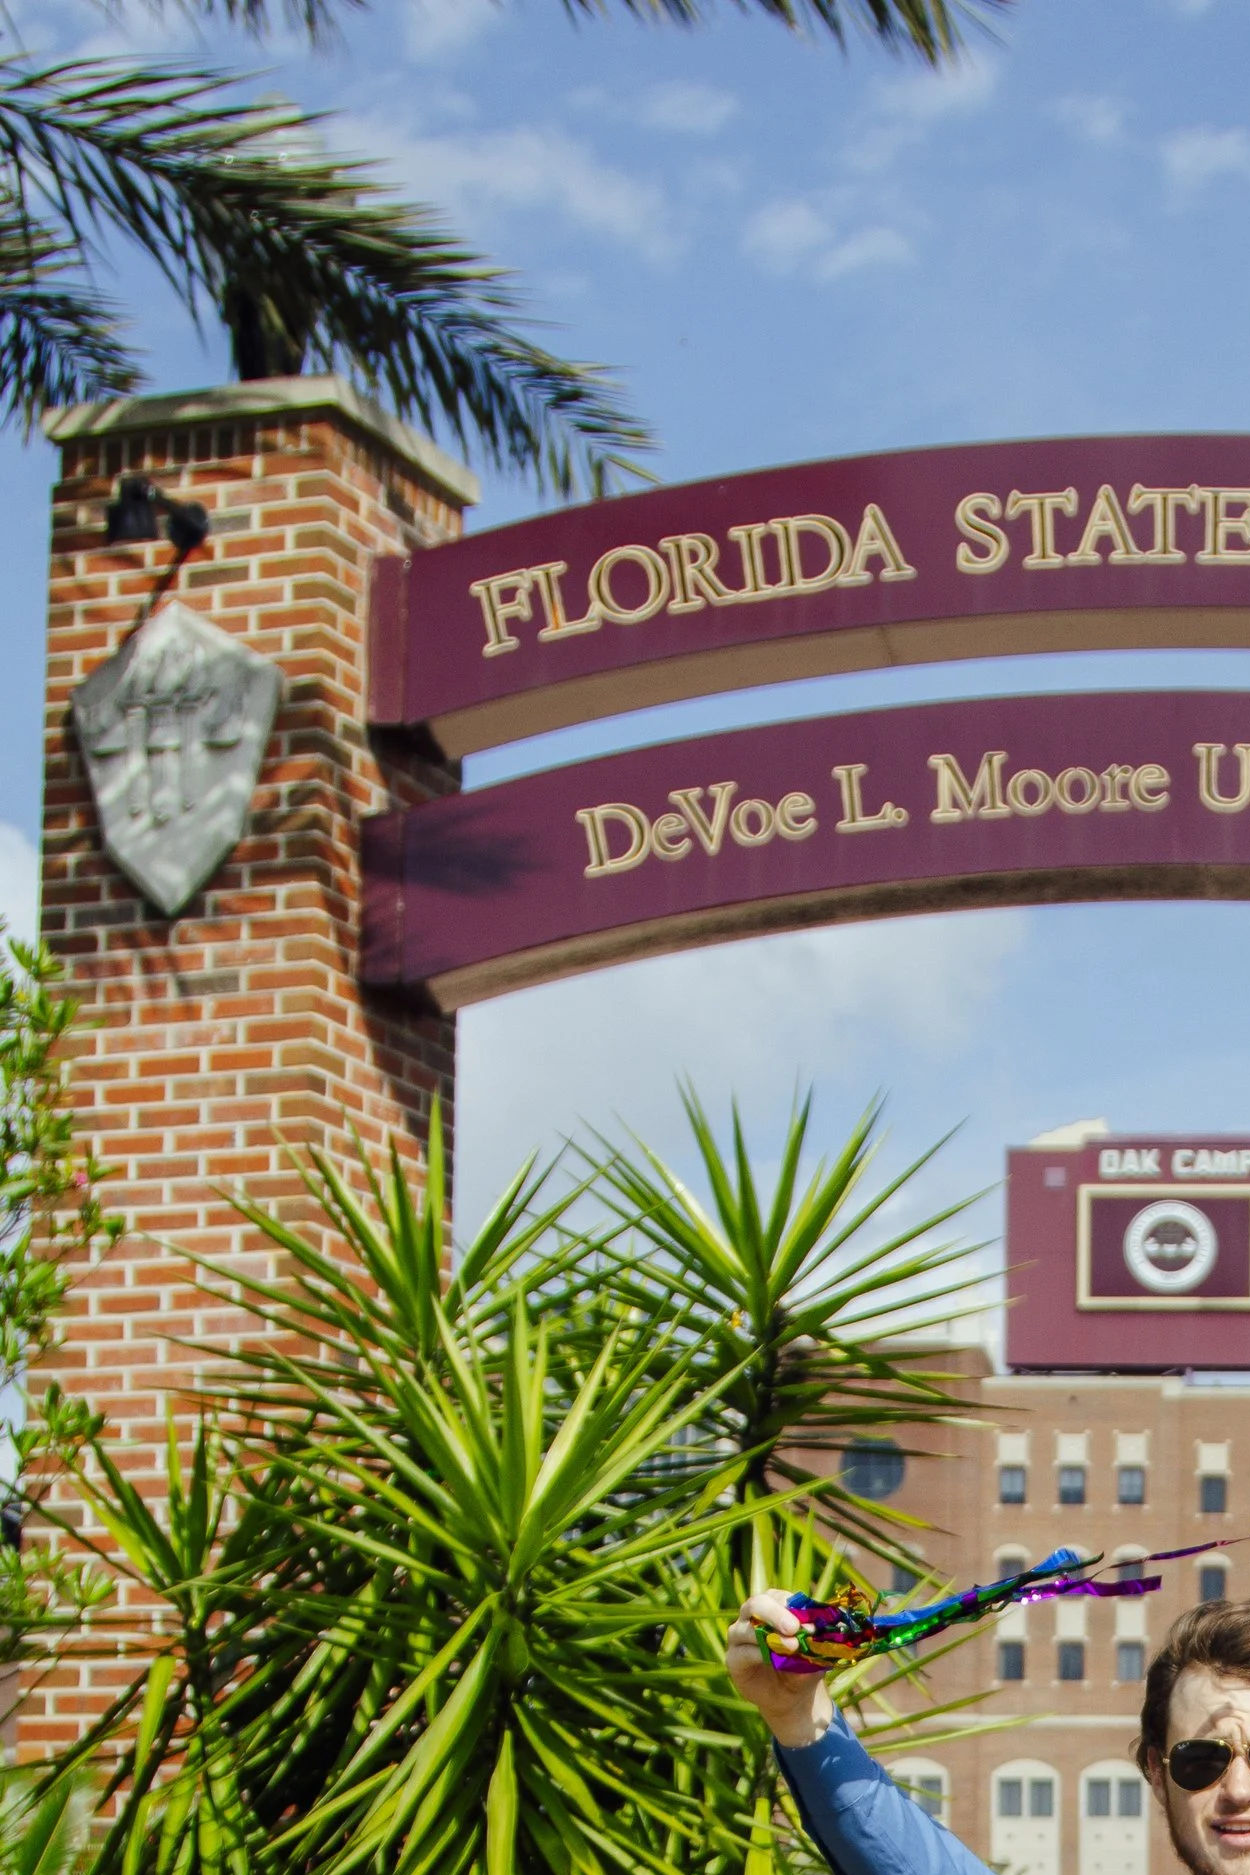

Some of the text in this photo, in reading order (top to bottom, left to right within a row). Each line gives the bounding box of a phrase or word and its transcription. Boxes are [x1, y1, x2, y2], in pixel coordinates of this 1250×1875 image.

[469, 503, 917, 657] FLORIDA
[574, 780, 818, 879] DeVoe
[833, 762, 908, 833] L.
[927, 749, 1171, 824] Moore
